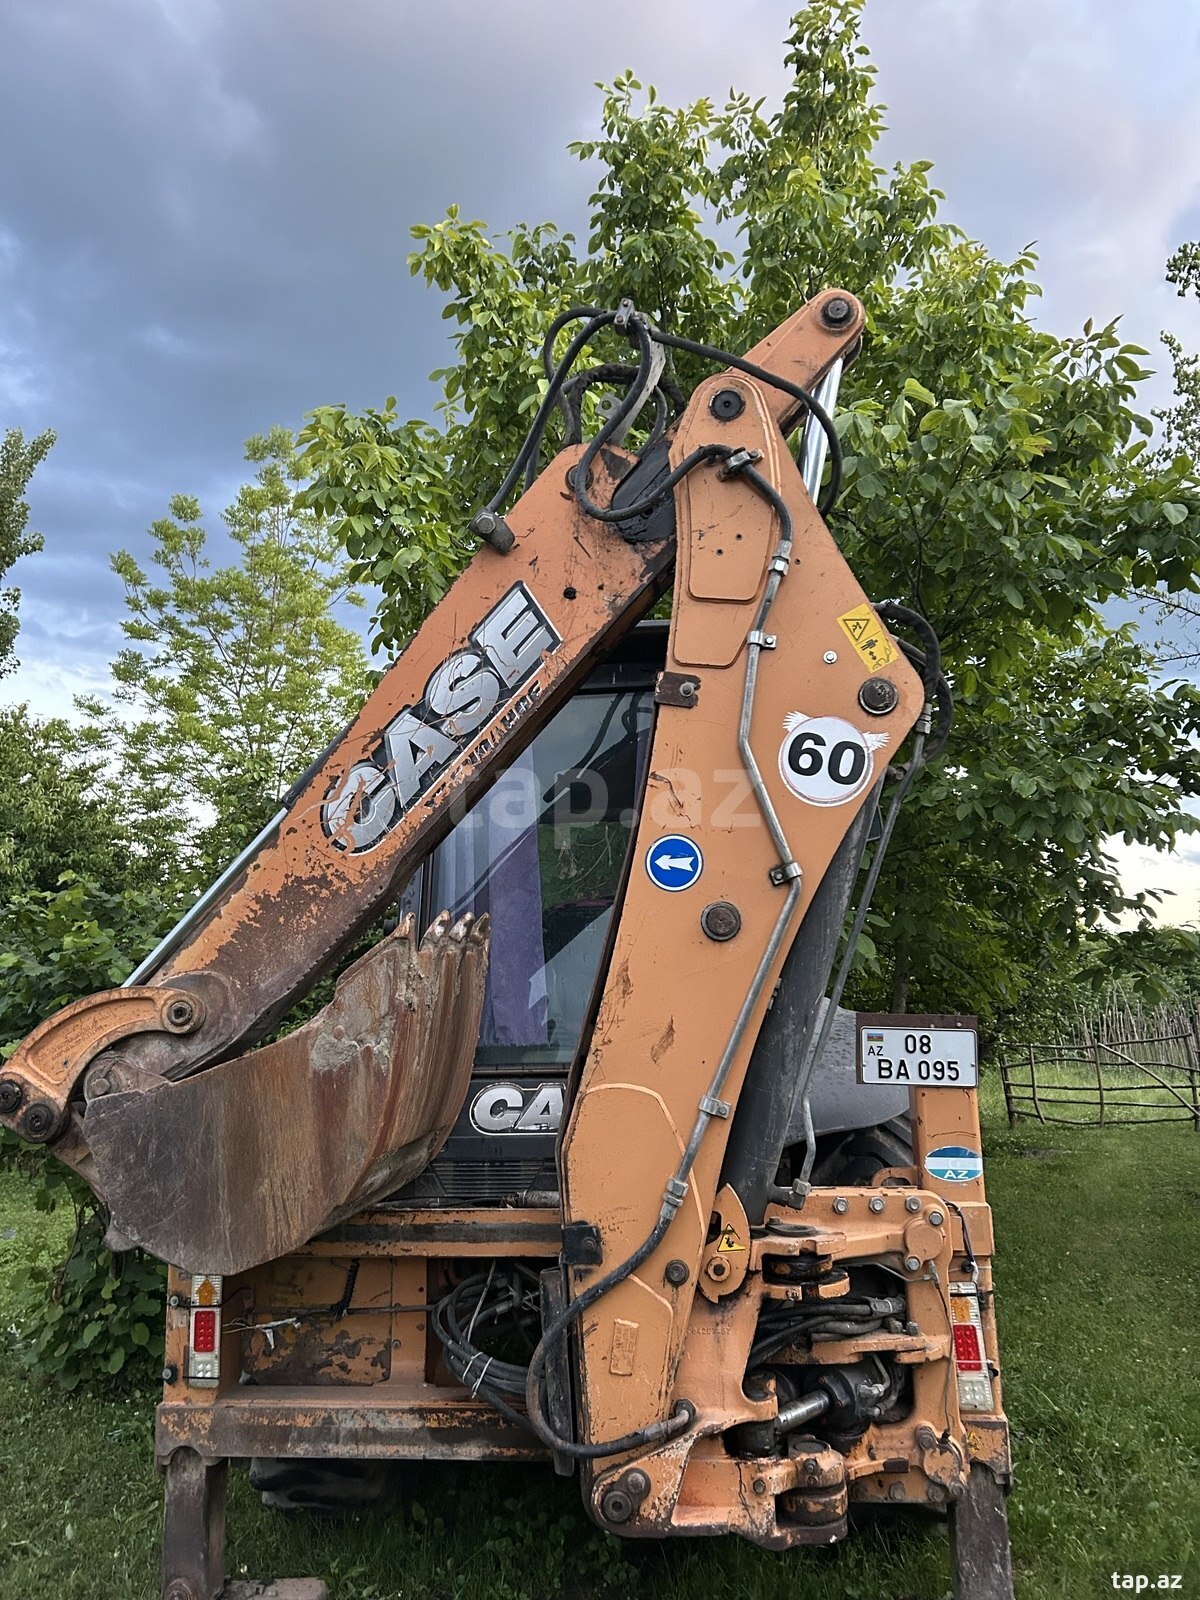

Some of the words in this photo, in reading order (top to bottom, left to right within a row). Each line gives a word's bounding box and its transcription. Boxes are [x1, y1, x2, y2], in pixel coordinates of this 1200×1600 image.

[321, 583, 559, 852] CASE
[788, 732, 865, 785] 60
[867, 1046, 883, 1056] AZ
[904, 1034, 932, 1054] 08
[878, 1059, 910, 1079] BA
[918, 1060, 960, 1080] 095
[943, 1170, 969, 1179] AZ
